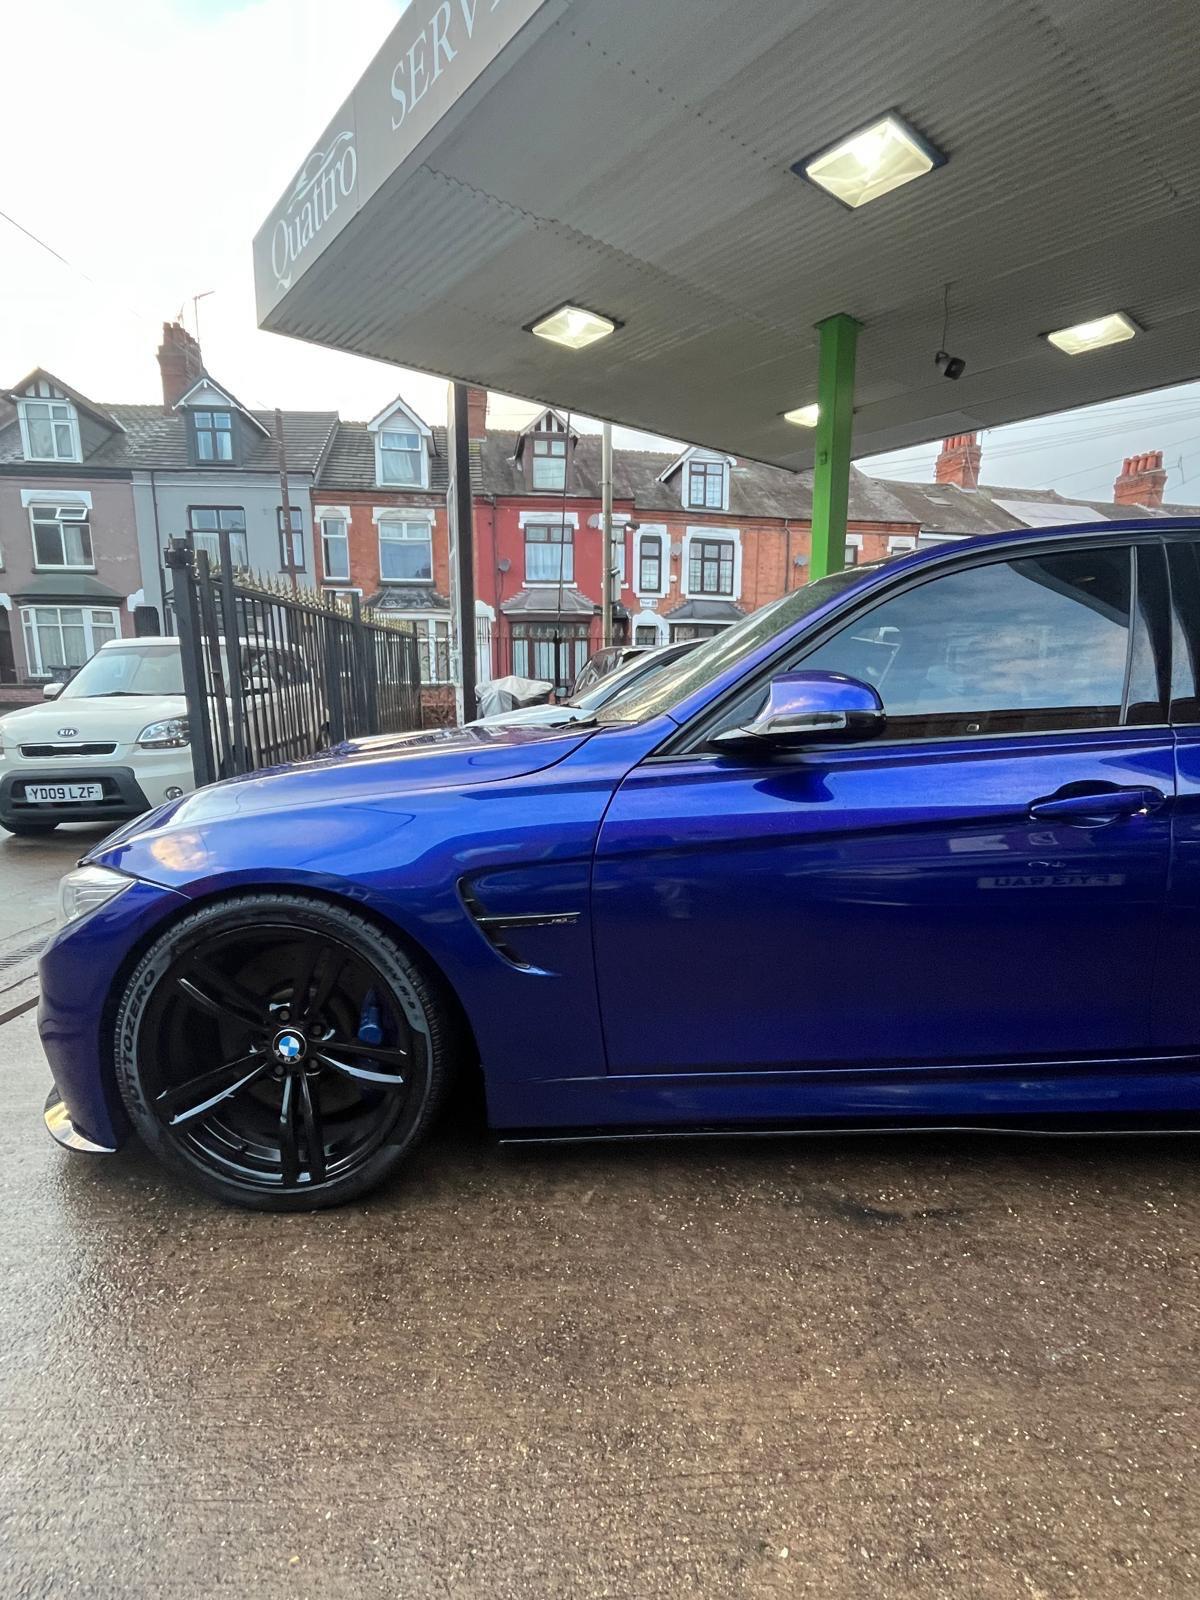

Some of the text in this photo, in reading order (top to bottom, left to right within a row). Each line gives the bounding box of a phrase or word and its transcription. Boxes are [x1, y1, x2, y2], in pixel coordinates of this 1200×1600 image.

[391, 0, 499, 130] SERV
[272, 146, 357, 289] Quattro
[31, 786, 95, 799] YD09 LZF
